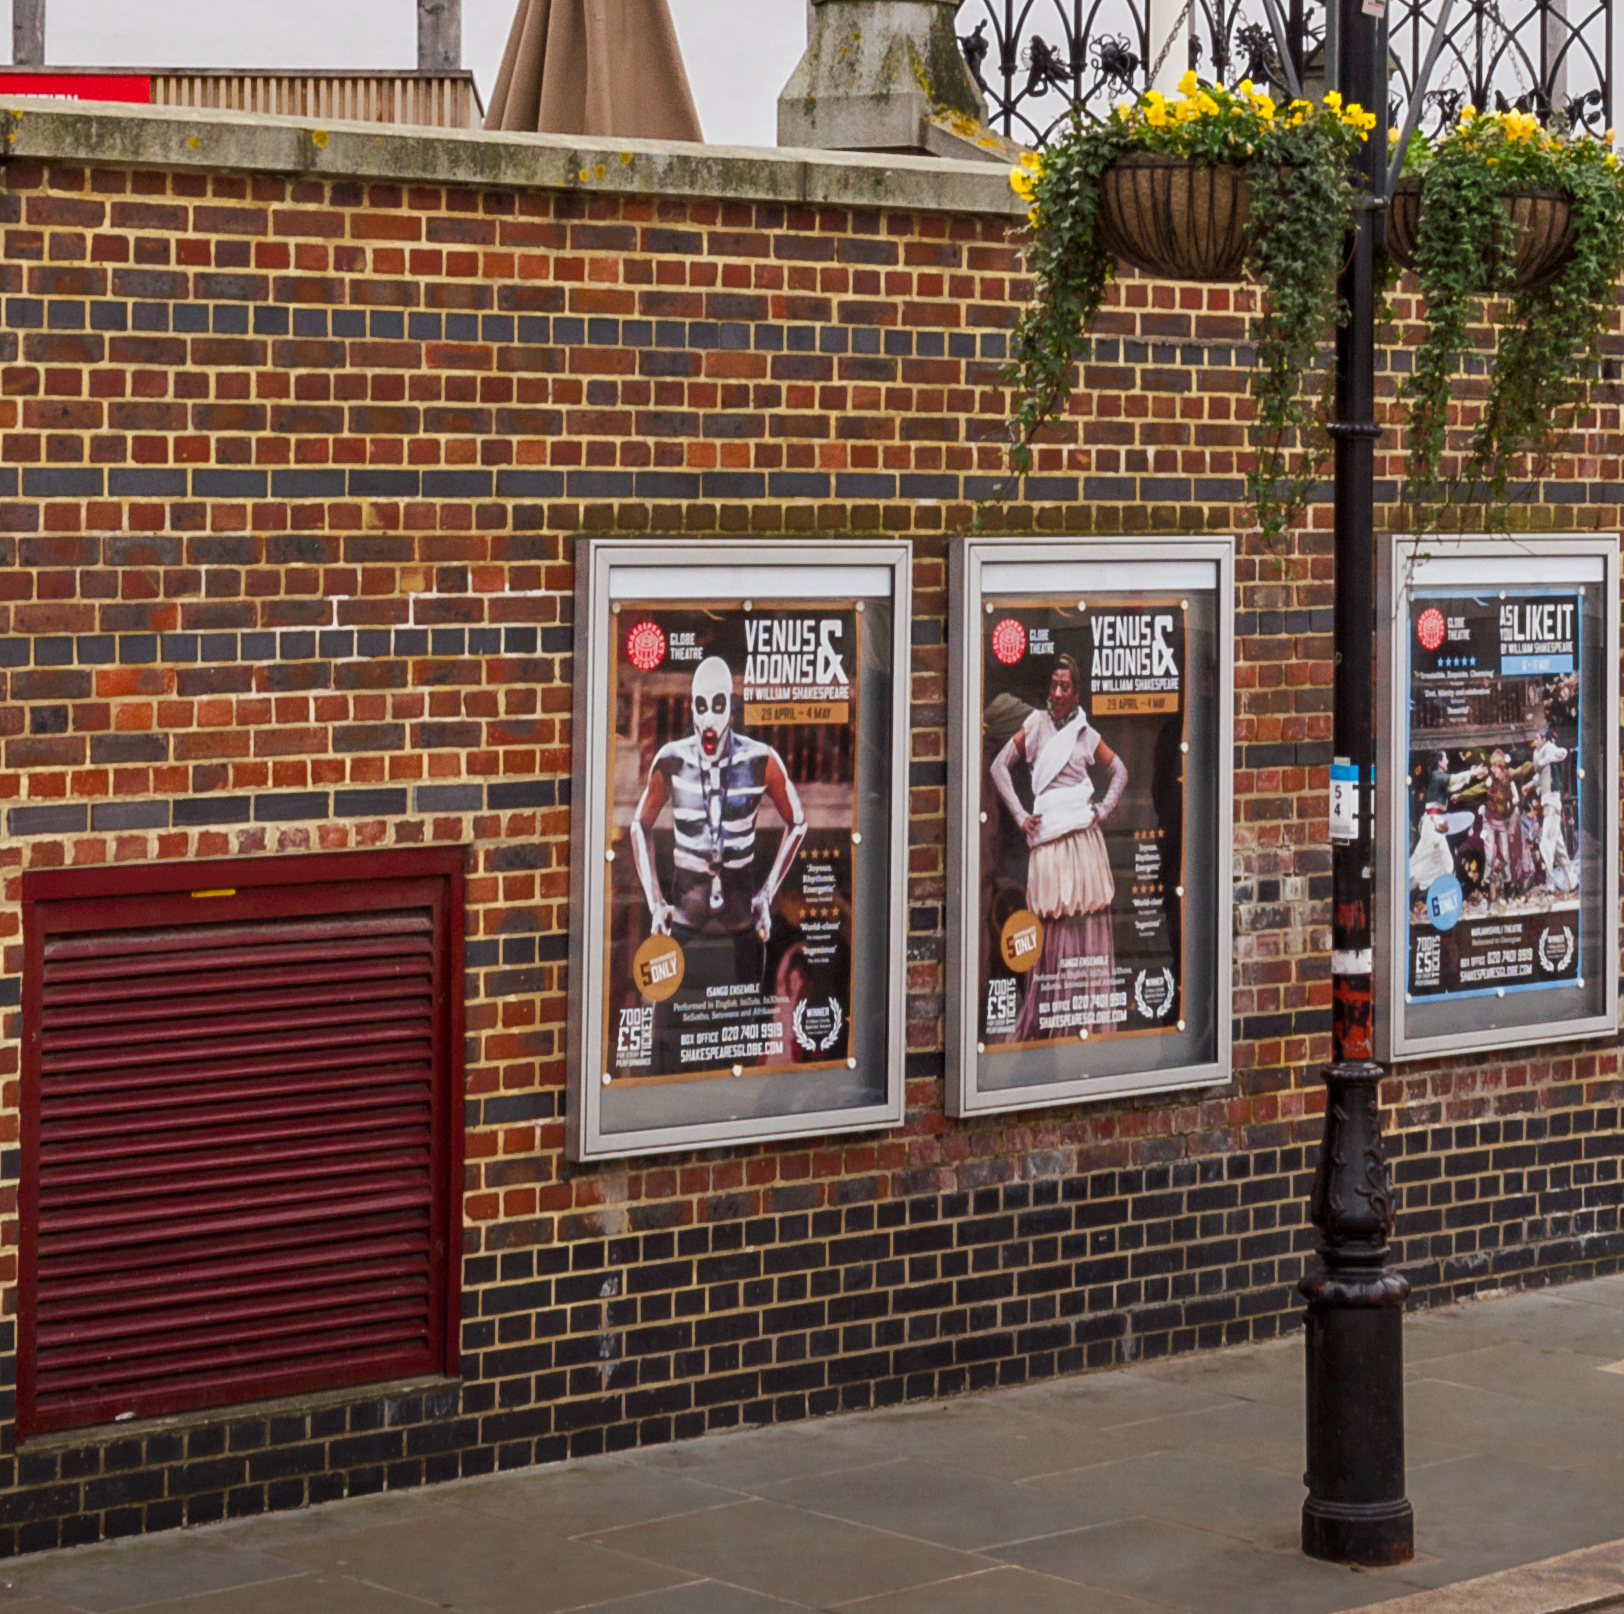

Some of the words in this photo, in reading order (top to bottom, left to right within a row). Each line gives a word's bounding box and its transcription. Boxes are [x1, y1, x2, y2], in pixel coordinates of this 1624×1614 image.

[1500, 604, 1513, 627] AS
[1513, 604, 1555, 642] LIKE
[1556, 603, 1574, 640] IT
[669, 632, 695, 647] GLOBE
[1090, 615, 1151, 647] VENUS
[1151, 614, 1179, 677] &
[670, 645, 703, 661] THEATRE
[744, 619, 816, 654] VENUS
[815, 619, 850, 685] &
[1090, 648, 1151, 677] ADONIS
[743, 653, 815, 685] ADONIS
[743, 687, 755, 702] BY
[755, 686, 791, 702] WILLIAM
[791, 686, 850, 701] SHAKESPEARE
[1091, 679, 1100, 693] BY
[1101, 678, 1134, 692] WILLIAM
[1134, 677, 1179, 691] SHAKESPEARE
[761, 708, 773, 722] 29
[773, 707, 797, 721] APRIL
[806, 707, 813, 720] 4
[813, 707, 832, 720] MAY
[1118, 698, 1139, 710] APRIL
[1152, 698, 1166, 709] MAY
[1333, 803, 1341, 817] 4
[1431, 896, 1441, 917] 6
[1015, 933, 1038, 957] ONLY
[1416, 936, 1432, 951] 700
[651, 956, 677, 983] ONLY
[1415, 952, 1432, 973] £5
[640, 961, 652, 987] 5
[988, 978, 1007, 997] 700
[986, 997, 1007, 1019] £5
[1006, 977, 1017, 1028] TICKETS
[1072, 994, 1089, 1011] 020
[1089, 993, 1109, 1009] 7401
[619, 1008, 641, 1027] 700
[616, 1026, 641, 1052] £5
[640, 1007, 653, 1059] TICKETS
[680, 1033, 695, 1046] BOX
[696, 1031, 719, 1045] OFFICE
[721, 1025, 739, 1043] 020
[740, 1024, 759, 1040] 7401
[760, 1022, 783, 1039] 9919
[680, 1040, 784, 1063] SHAKESPEARESGLOBE.COM
